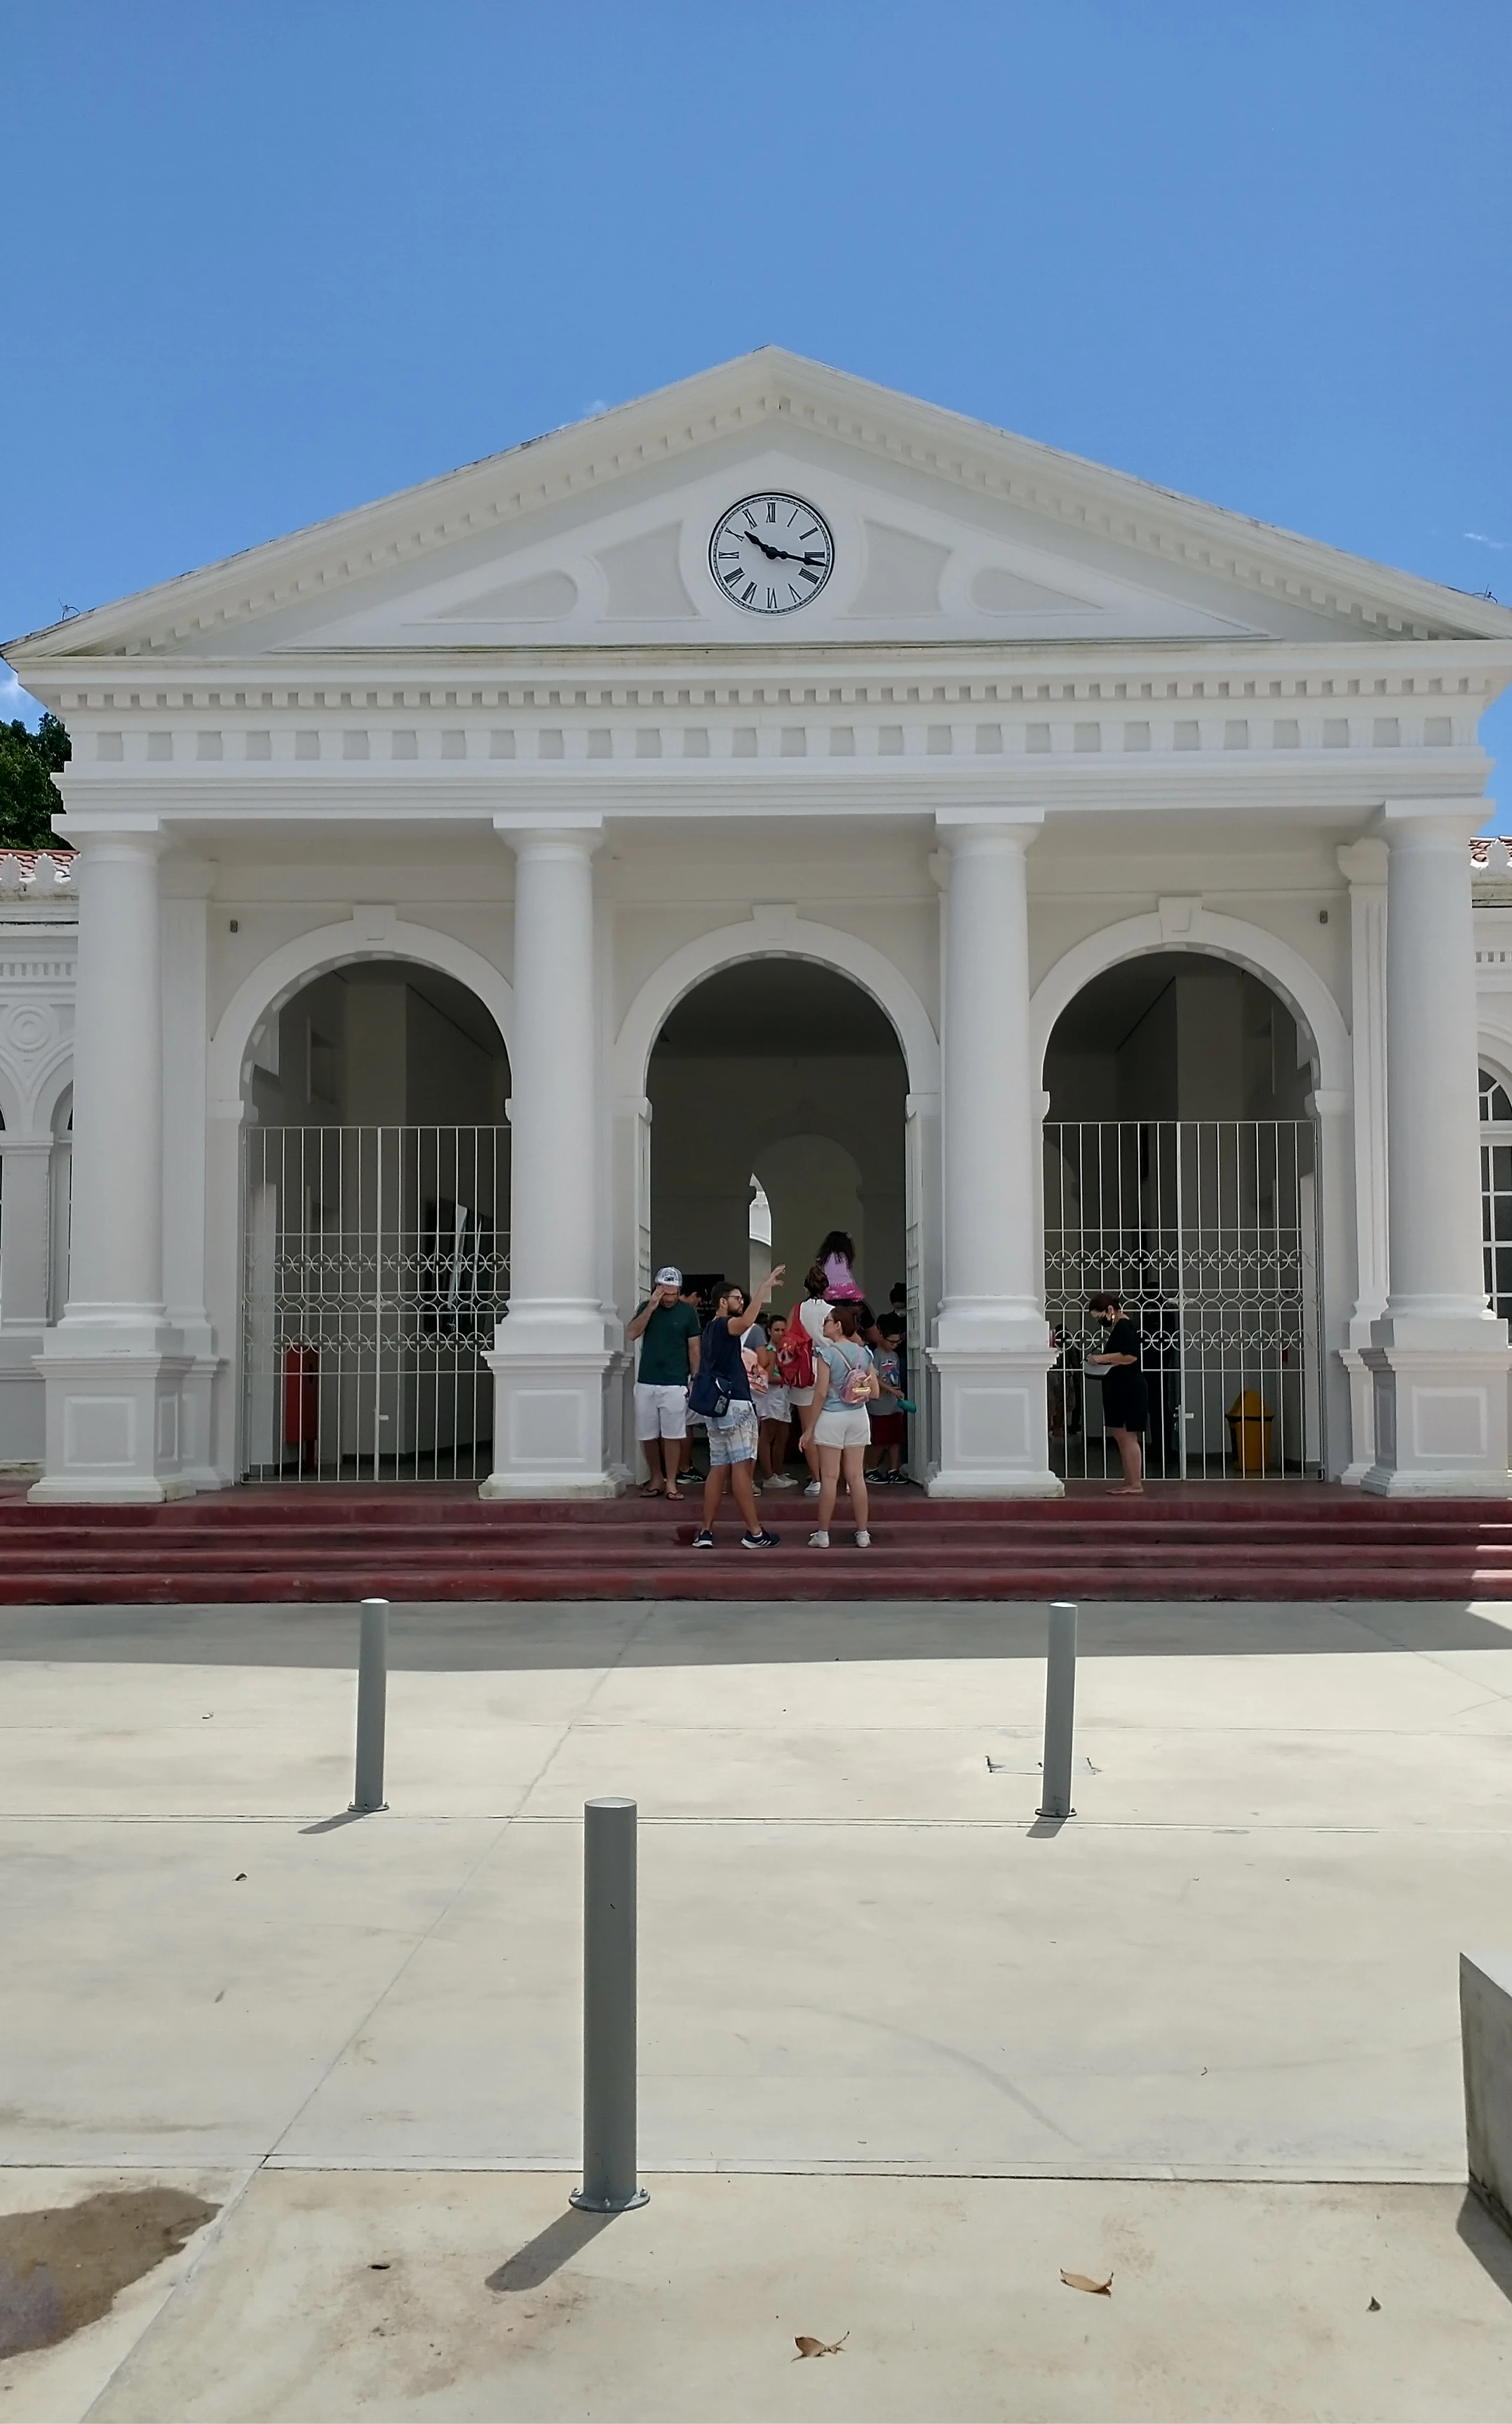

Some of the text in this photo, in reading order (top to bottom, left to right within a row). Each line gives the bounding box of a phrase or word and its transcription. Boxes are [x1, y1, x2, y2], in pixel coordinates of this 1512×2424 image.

[742, 509, 758, 530] XI
[766, 502, 776, 523] XII
[787, 509, 799, 527] I
[724, 527, 744, 541] X
[799, 527, 819, 540] II
[723, 567, 745, 588] VIII
[798, 567, 821, 585] IIII
[741, 581, 757, 604] VII
[767, 588, 778, 609] VI
[788, 583, 802, 603] V
